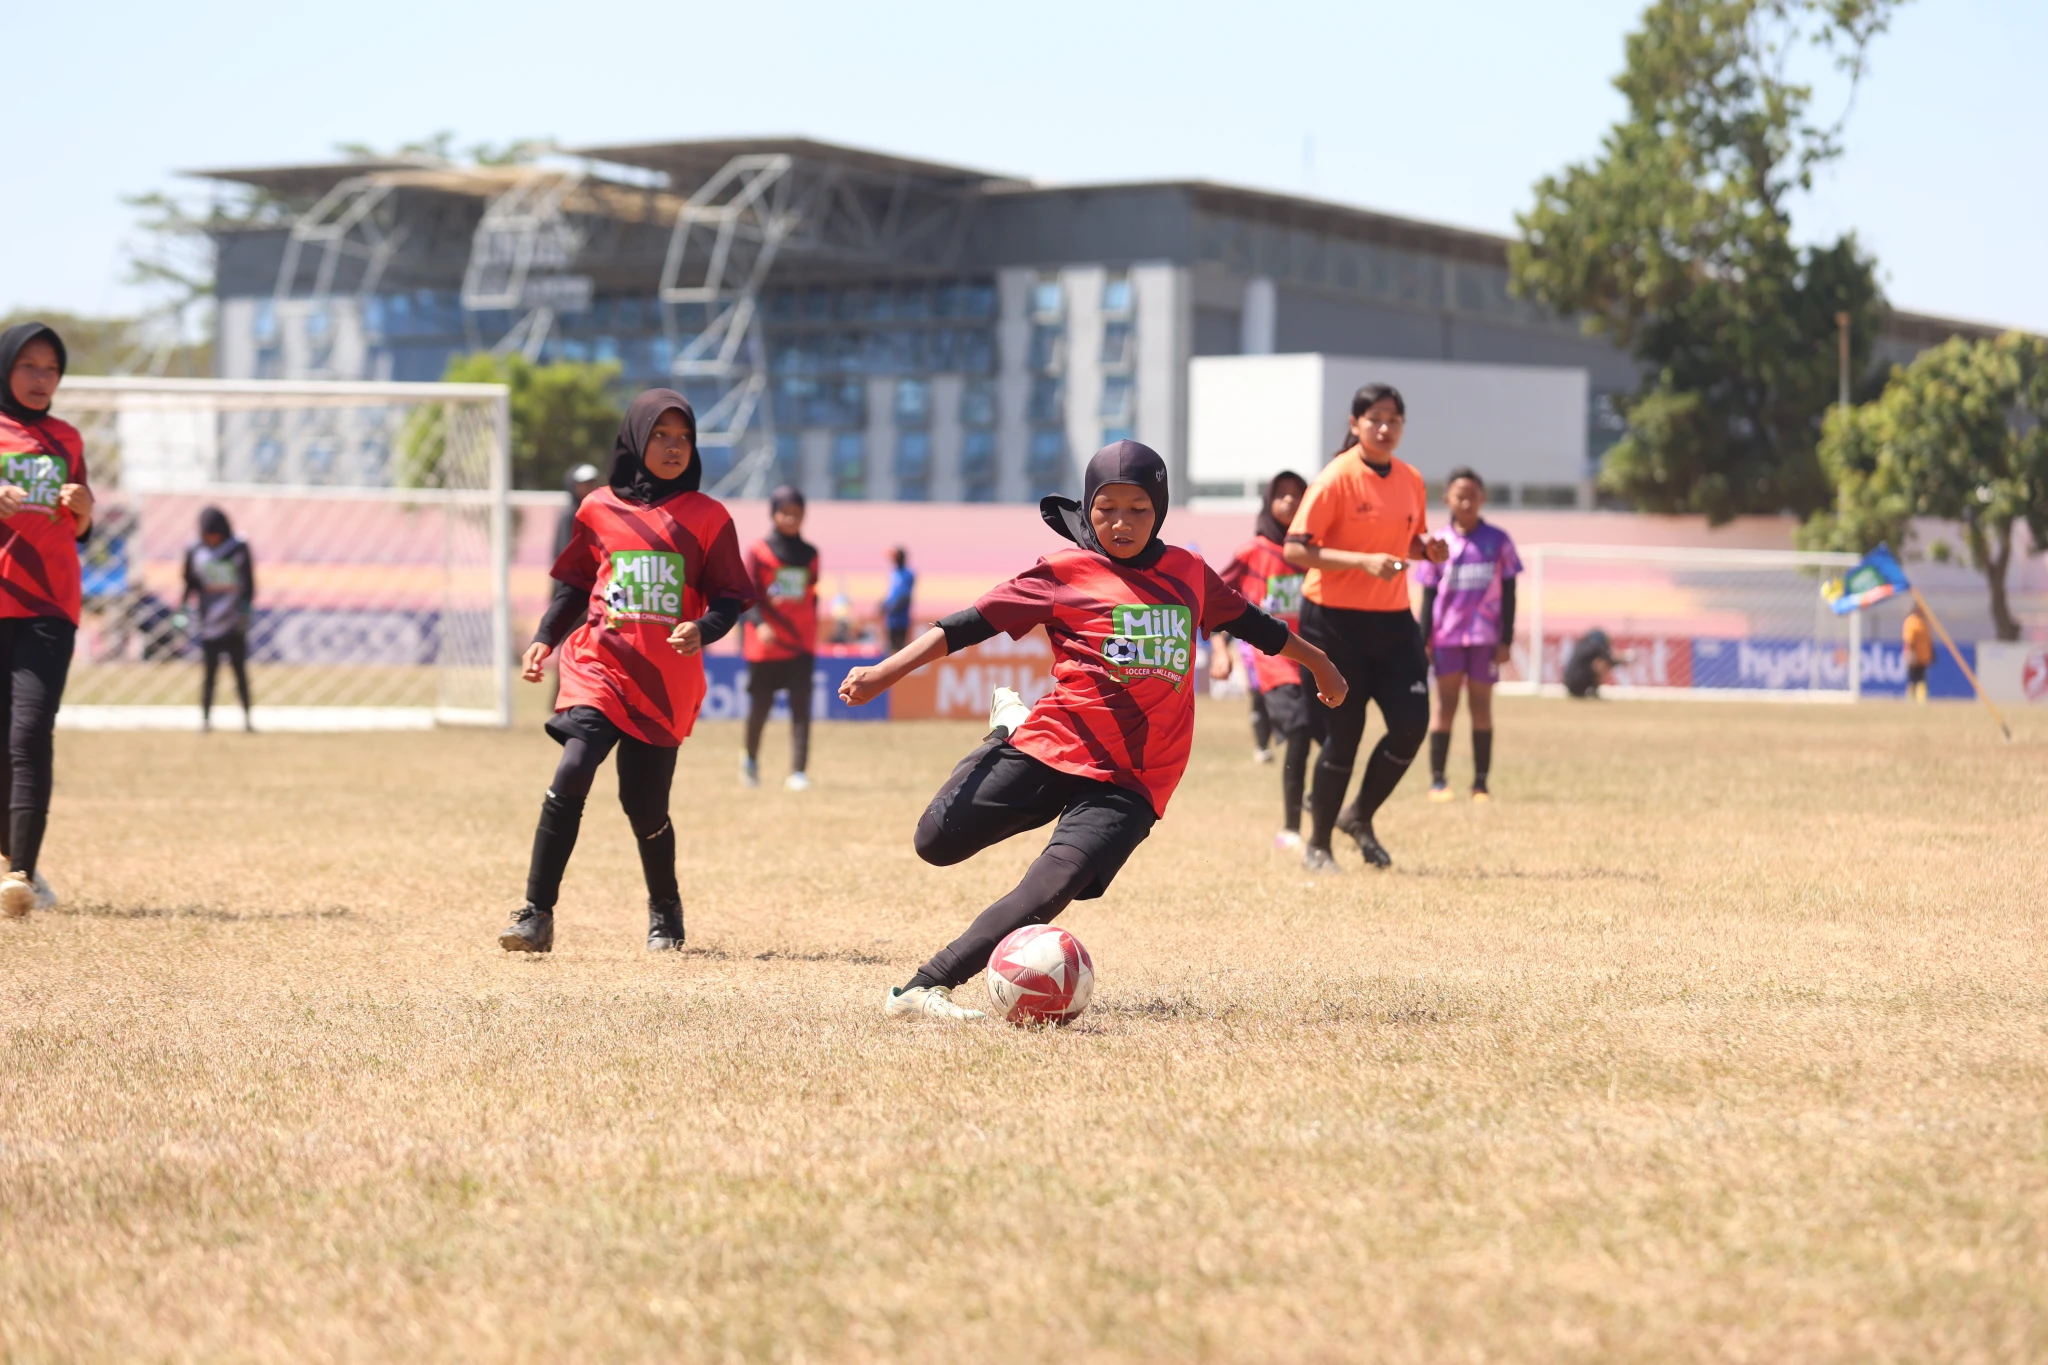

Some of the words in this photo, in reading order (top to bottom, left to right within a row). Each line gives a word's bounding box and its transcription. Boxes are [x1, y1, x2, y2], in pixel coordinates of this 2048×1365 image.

[616, 555, 679, 586] Milk
[626, 583, 679, 613] Life
[1123, 609, 1188, 641] Milk
[1137, 638, 1187, 670] Life
